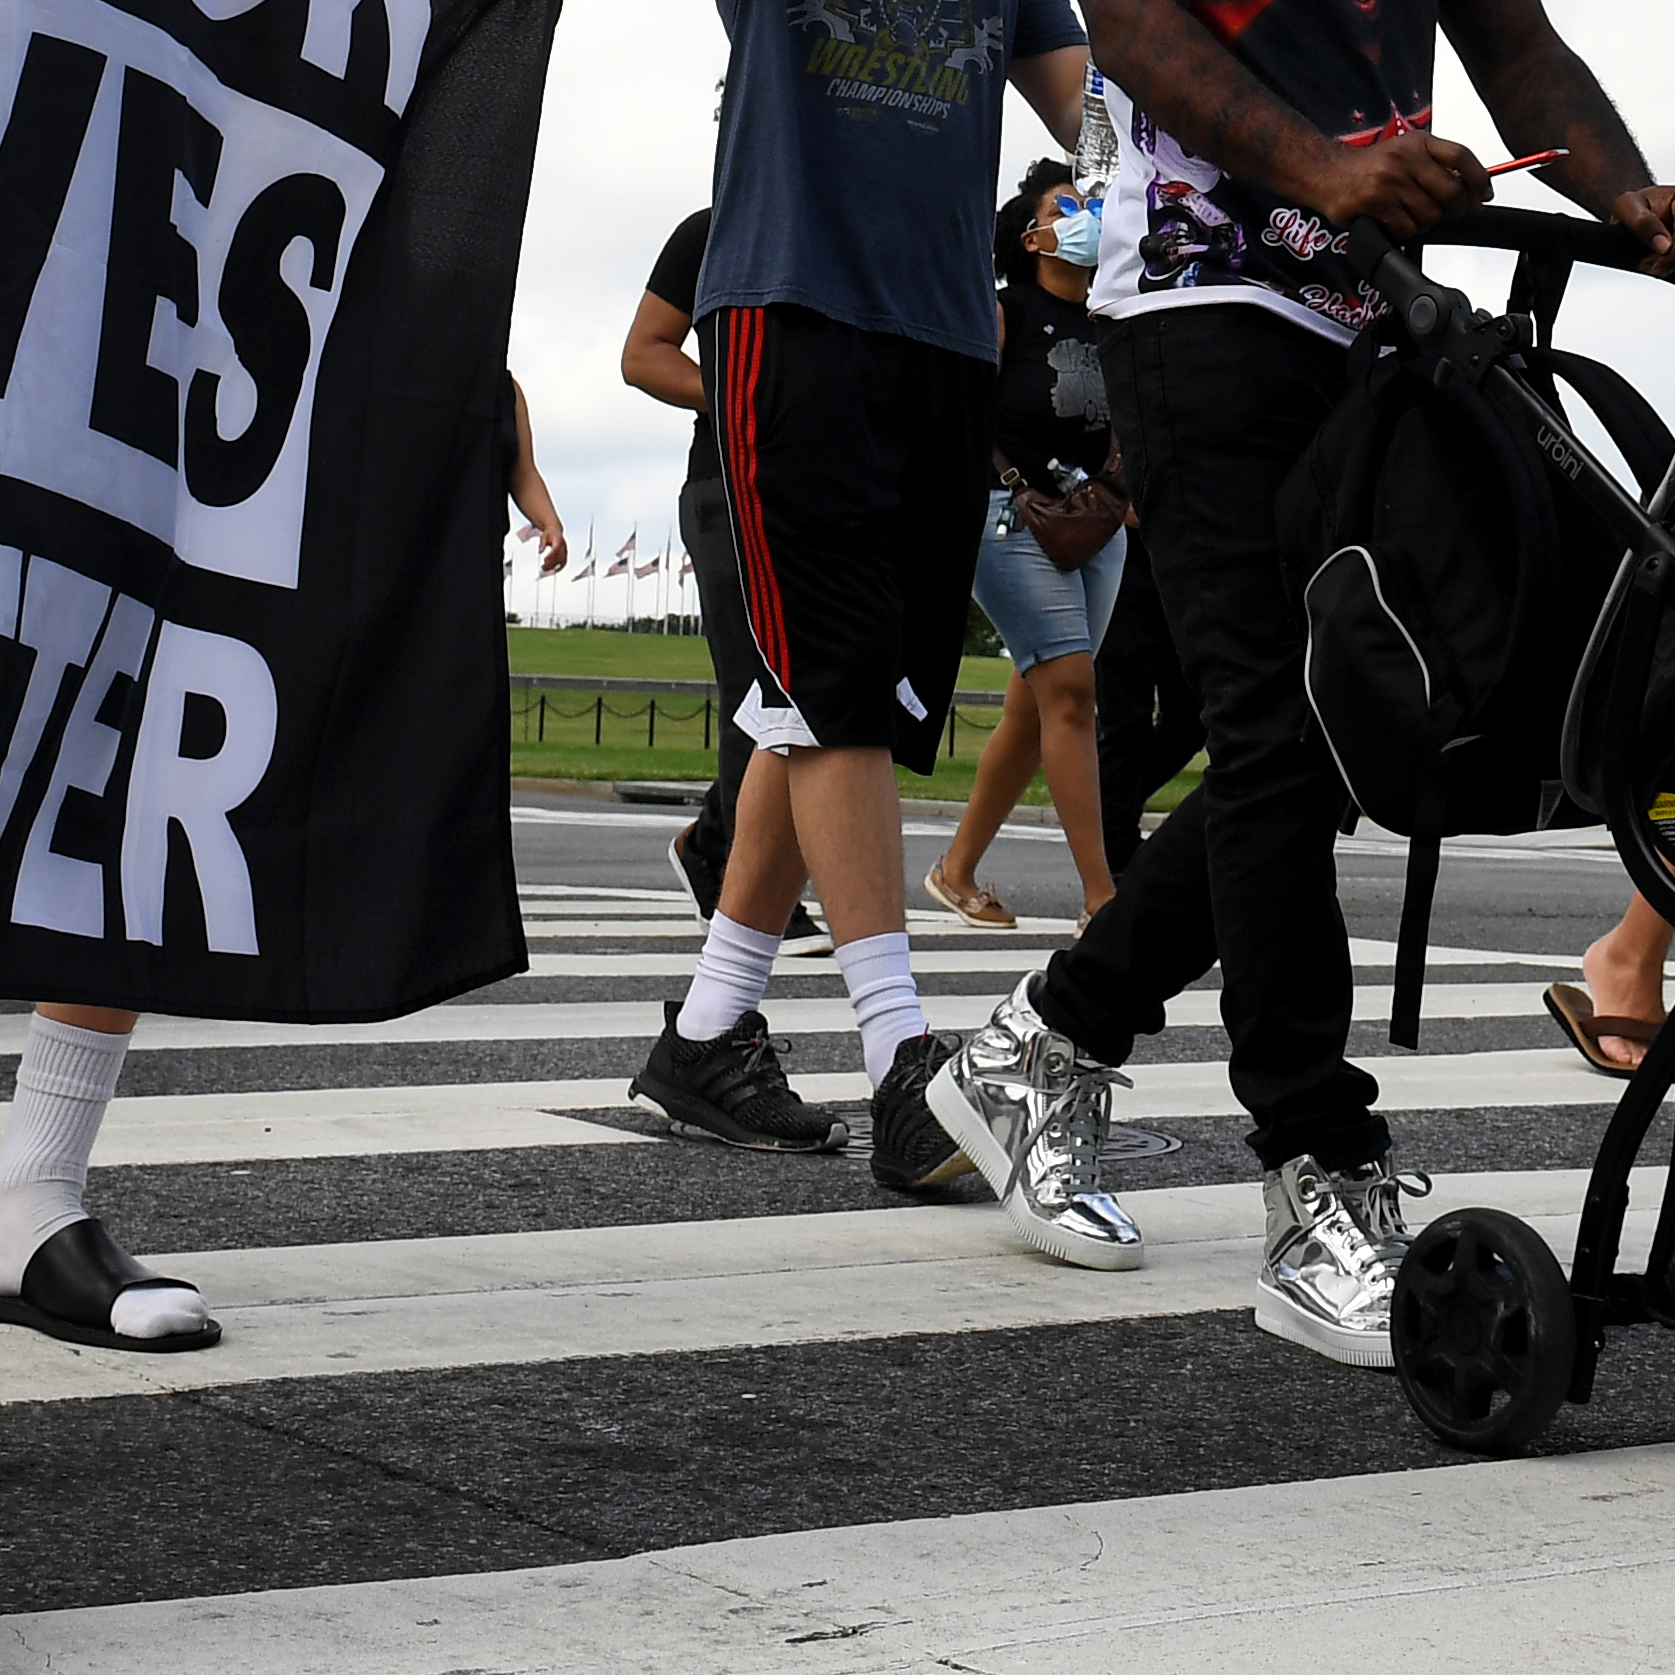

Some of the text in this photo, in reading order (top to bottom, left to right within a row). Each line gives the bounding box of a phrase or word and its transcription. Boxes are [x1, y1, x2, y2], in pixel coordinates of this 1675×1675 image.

[826, 78, 951, 119] CHAMPIONSHIPS
[1261, 208, 1333, 261] Life
[1537, 425, 1584, 481] urbini
